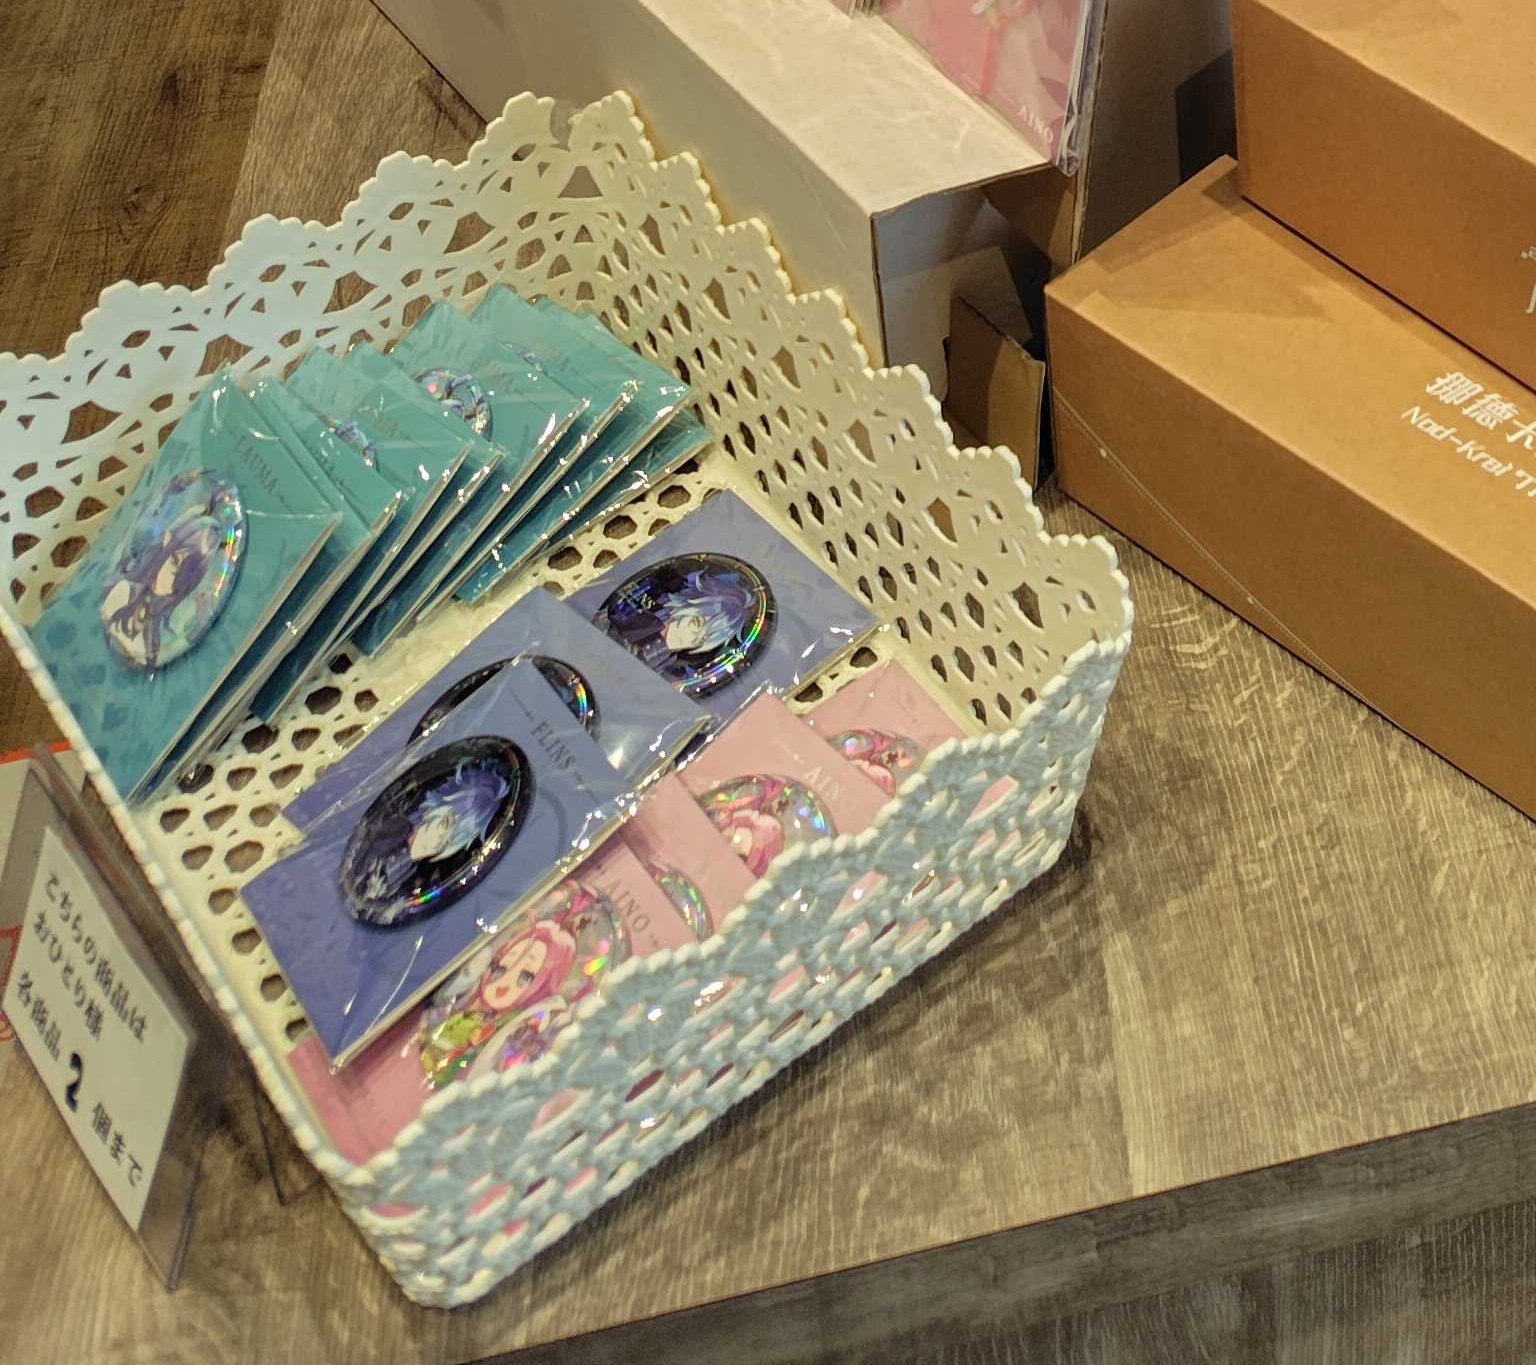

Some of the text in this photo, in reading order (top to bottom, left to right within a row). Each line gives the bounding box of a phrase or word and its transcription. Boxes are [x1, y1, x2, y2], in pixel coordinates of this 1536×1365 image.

[1018, 104, 1054, 145] AINO
[1401, 404, 1513, 478] Nod-Krai
[529, 719, 578, 771] FLINS
[605, 877, 650, 932] AINO
[32, 907, 106, 1042] おひとり様
[44, 871, 151, 1046] こちらの商品は
[65, 1050, 86, 1115] 2
[90, 1098, 145, 1188] 個まで
